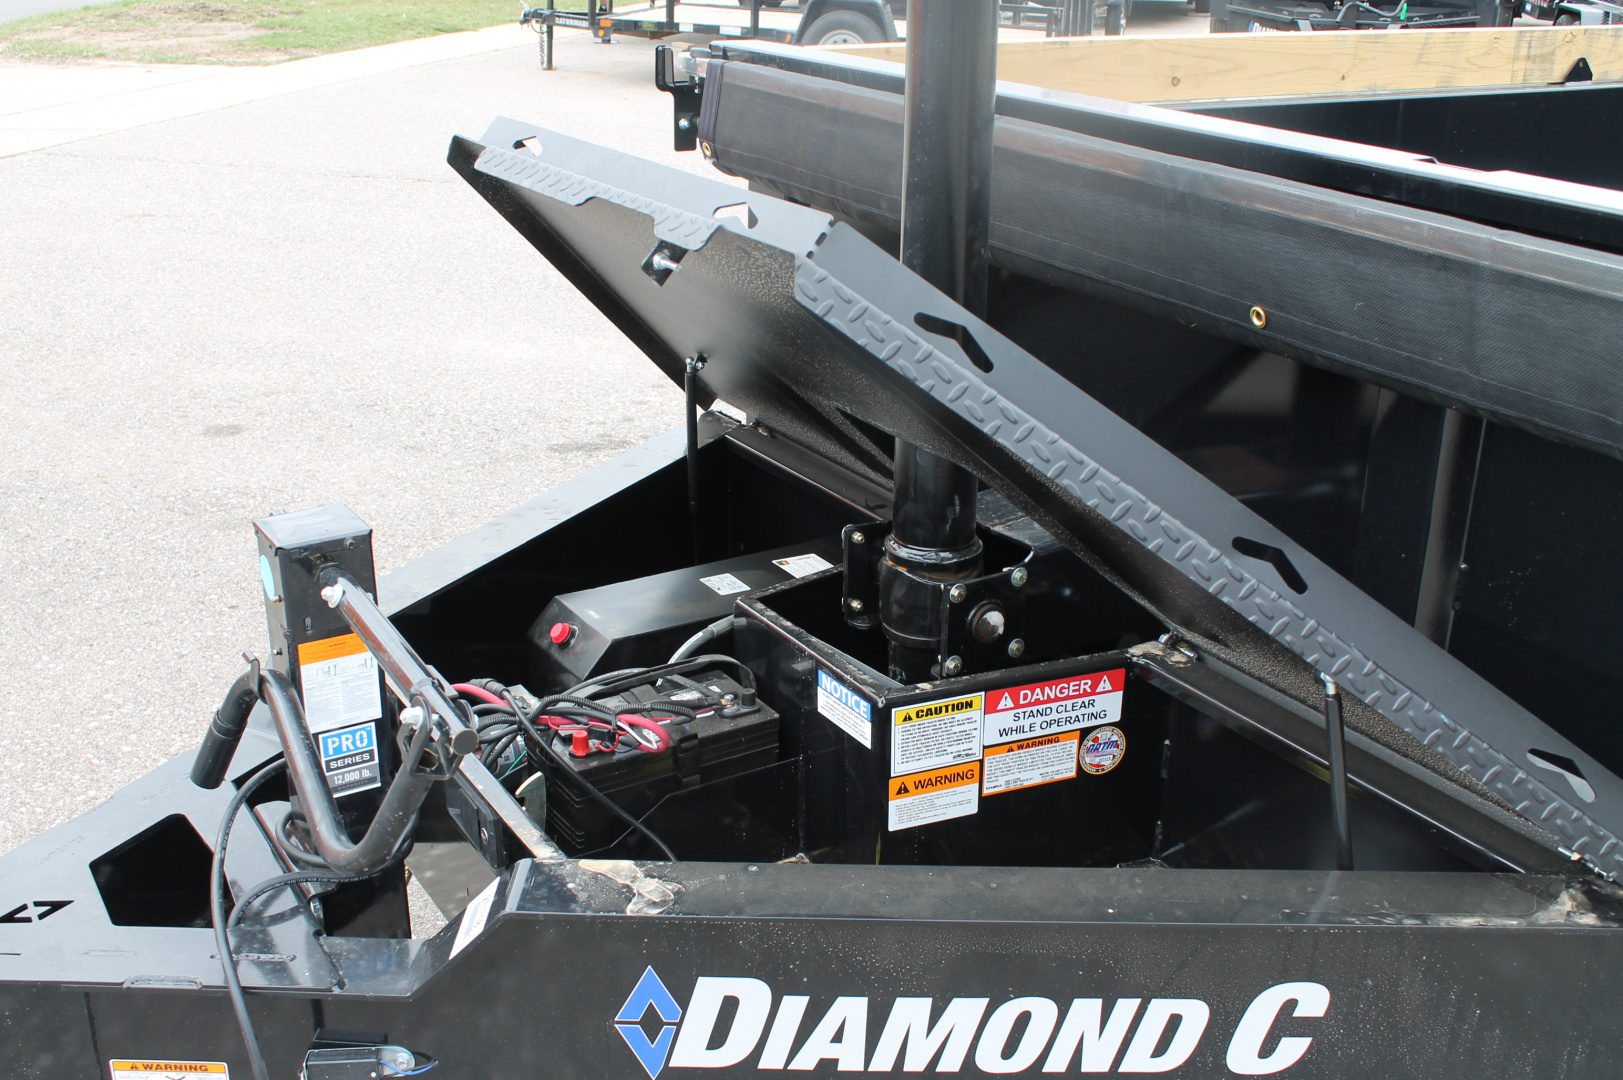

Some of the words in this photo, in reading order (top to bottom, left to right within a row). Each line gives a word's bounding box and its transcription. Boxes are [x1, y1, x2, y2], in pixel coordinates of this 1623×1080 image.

[821, 673, 868, 718] NOTICE
[1019, 679, 1092, 705] DANGER
[915, 699, 974, 719] CAUTION
[1013, 706, 1053, 722] STAND
[1055, 699, 1096, 715] CLEAR
[998, 723, 1037, 738] WHILE
[1039, 709, 1108, 730] OPERATING
[327, 729, 369, 756] PRO
[1017, 736, 1060, 751] WARNING
[329, 752, 371, 769] SERIES
[333, 770, 360, 785] 12,000
[361, 768, 373, 778] lb.
[337, 779, 369, 791] CAPACITY
[913, 769, 976, 791] WARNING
[668, 976, 1211, 1074] DIAMOND
[1225, 981, 1331, 1076] C
[142, 1063, 209, 1072] WARNING
